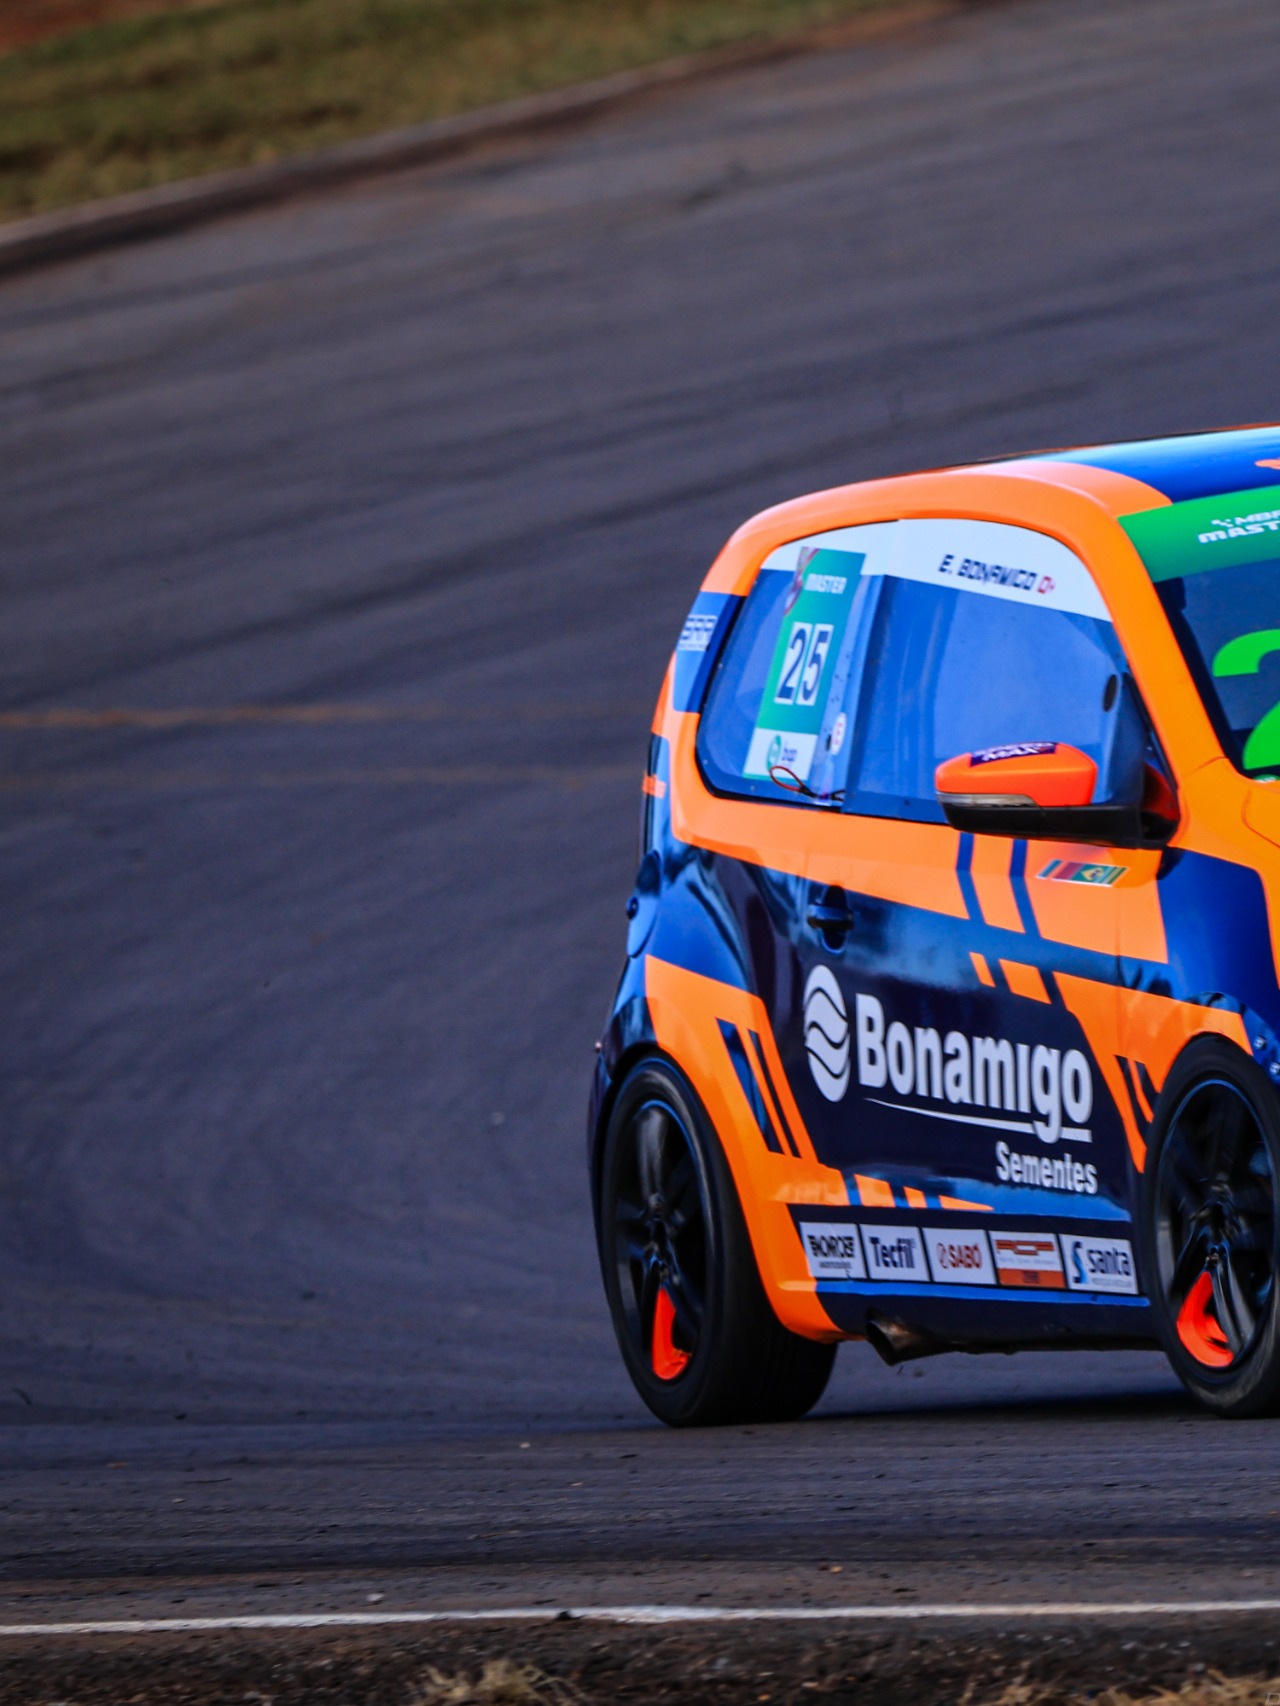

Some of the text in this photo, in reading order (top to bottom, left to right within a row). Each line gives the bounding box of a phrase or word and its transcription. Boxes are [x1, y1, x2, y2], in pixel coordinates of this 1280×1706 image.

[777, 627, 830, 702] 25
[855, 992, 1093, 1143] Bonamigo
[996, 1140, 1098, 1195] Sementes
[869, 1236, 915, 1268] Tecfil
